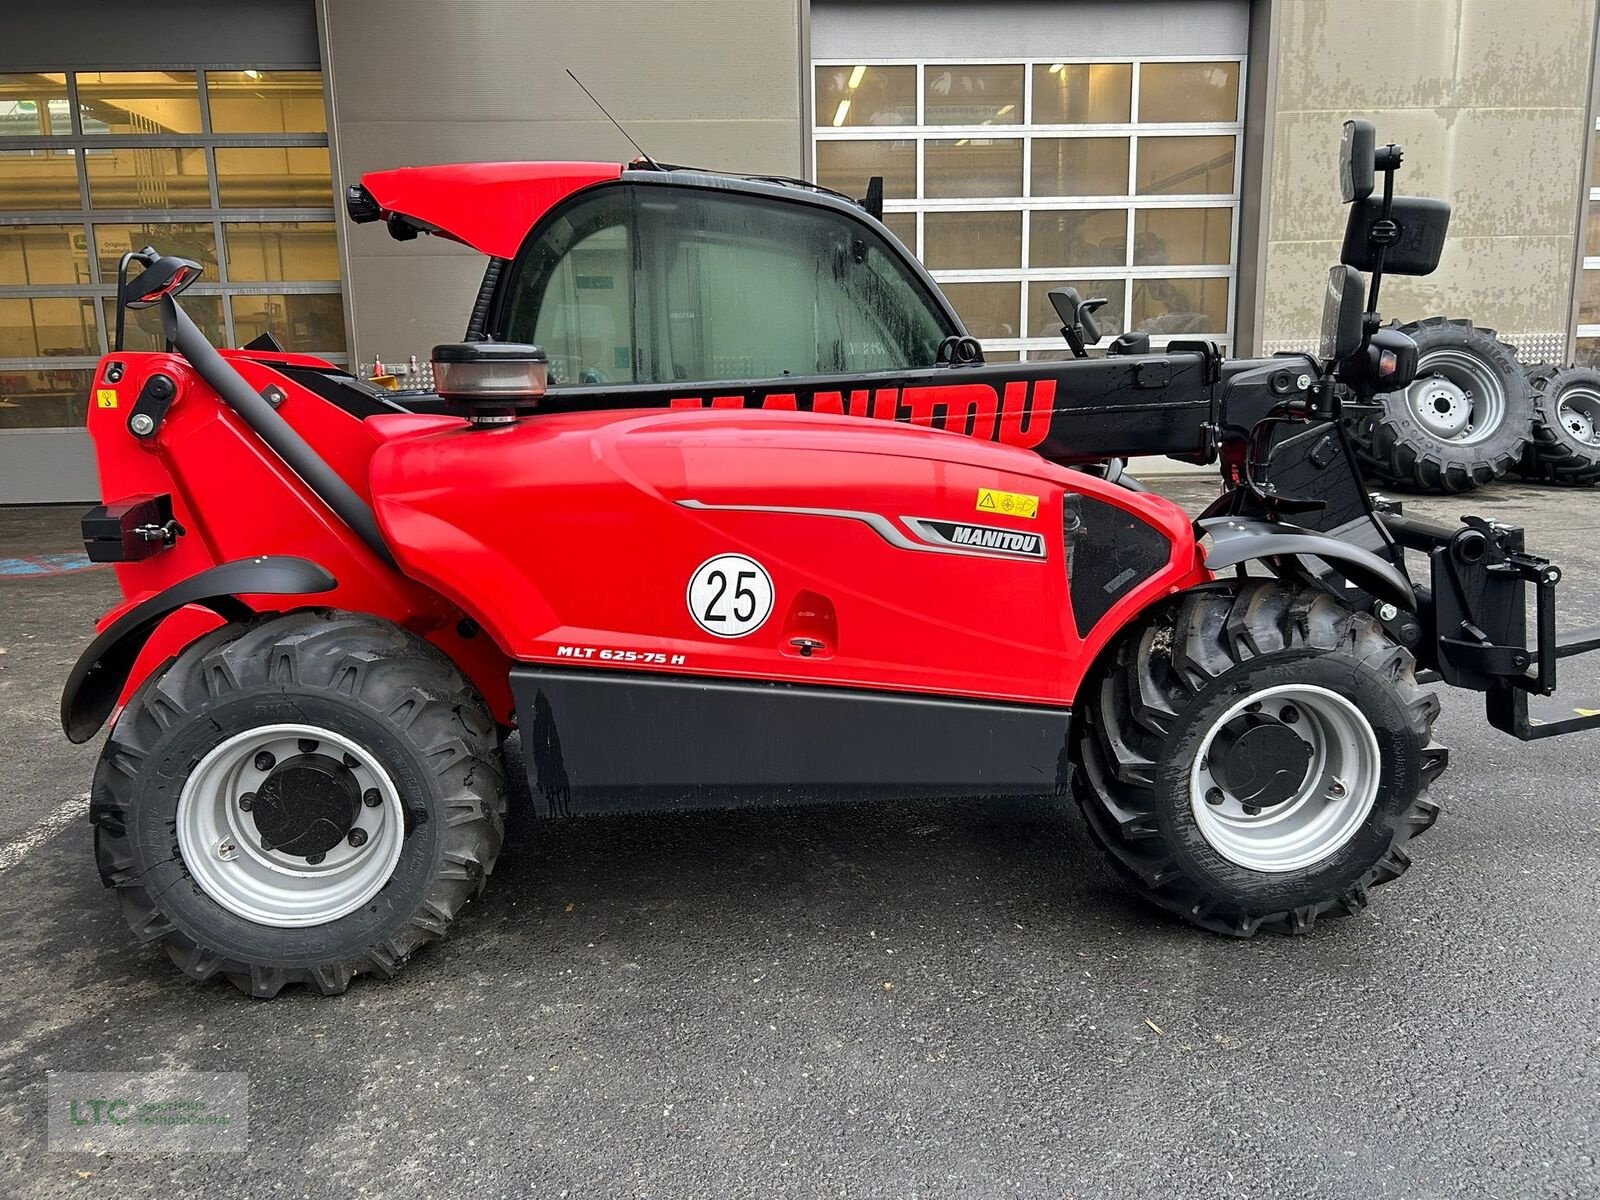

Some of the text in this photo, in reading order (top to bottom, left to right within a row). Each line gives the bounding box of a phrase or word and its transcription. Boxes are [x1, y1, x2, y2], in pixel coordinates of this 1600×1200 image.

[951, 526, 1037, 552] MANITOU
[703, 570, 757, 623] 25
[557, 646, 686, 665] MLT 625-75 H
